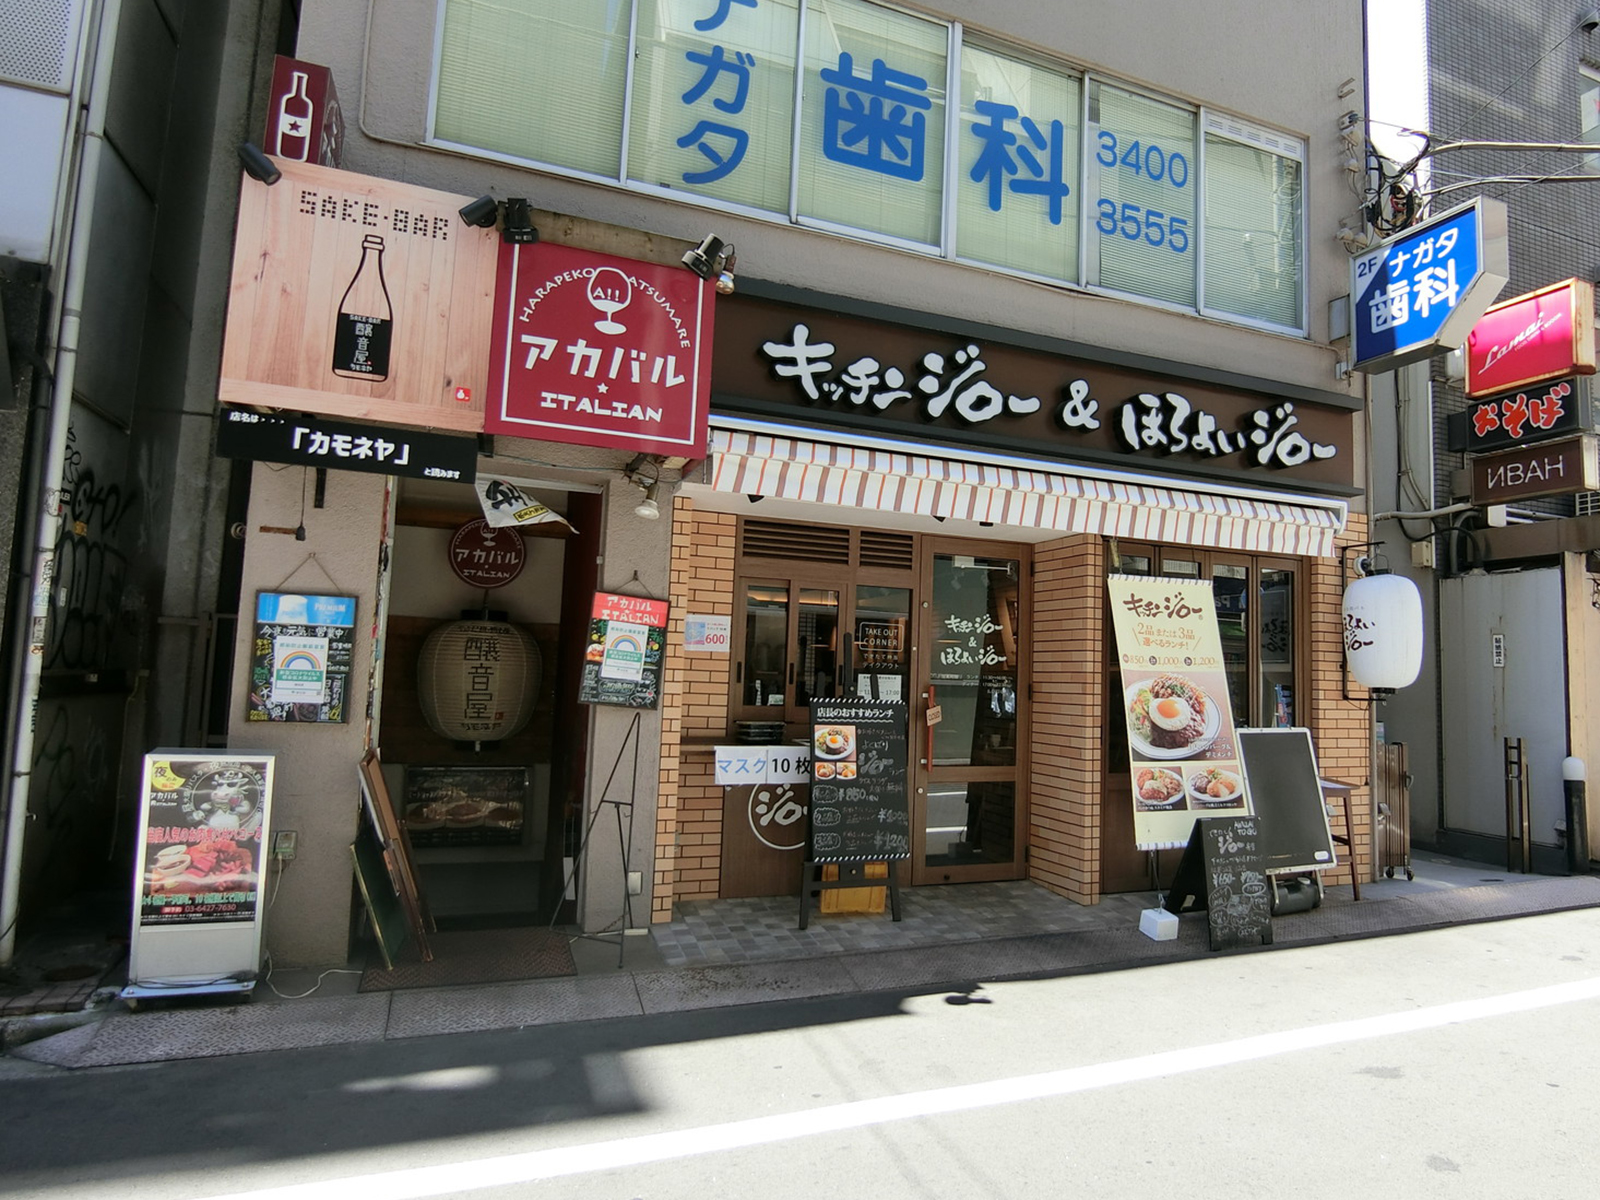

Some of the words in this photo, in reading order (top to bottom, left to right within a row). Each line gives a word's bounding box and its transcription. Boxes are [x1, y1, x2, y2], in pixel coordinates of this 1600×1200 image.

[820, 51, 1070, 226] 歯科
[1096, 130, 1189, 189] 3400
[1094, 198, 1190, 254] 3555
[1356, 255, 1379, 279] 2F
[1389, 226, 1460, 278] ナガタ
[592, 285, 620, 302] A!!
[1368, 258, 1461, 334] 歯科
[519, 266, 596, 323] HARAPEKO
[629, 276, 692, 349] ATSUMARE
[520, 334, 686, 388] アカバル
[762, 323, 1041, 423] キッチンジロー
[1061, 379, 1101, 431] &
[1121, 393, 1338, 469] ほろよいジロー
[540, 390, 663, 423] ITALIAN
[1472, 382, 1571, 439] おそば
[292, 427, 411, 466] 「カモネヤ」
[423, 467, 461, 480] と読みます
[1487, 454, 1564, 490] ИВАН
[456, 548, 519, 565] アカバル
[463, 568, 510, 578] ITALIAN
[607, 595, 652, 612] アカバル
[1122, 591, 1203, 619] キッチンジロー
[601, 609, 659, 625] ITALIAN
[944, 613, 1004, 634] キッチンジロー
[705, 633, 725, 645] 600
[865, 627, 882, 636] TAKE
[883, 629, 898, 637] OUT
[863, 637, 898, 647] CORNER
[968, 636, 978, 648] &
[1142, 637, 1189, 650] 選べるランチ!
[940, 645, 1007, 666] ほろよいジロー
[1157, 657, 1179, 665] 1,000
[1192, 657, 1215, 666] 1,200
[862, 661, 900, 670] テイクアウト
[816, 706, 894, 719] 店長のおすすめランチ
[153, 765, 168, 779] 夜
[717, 757, 767, 775] マスク
[771, 757, 791, 775] 10
